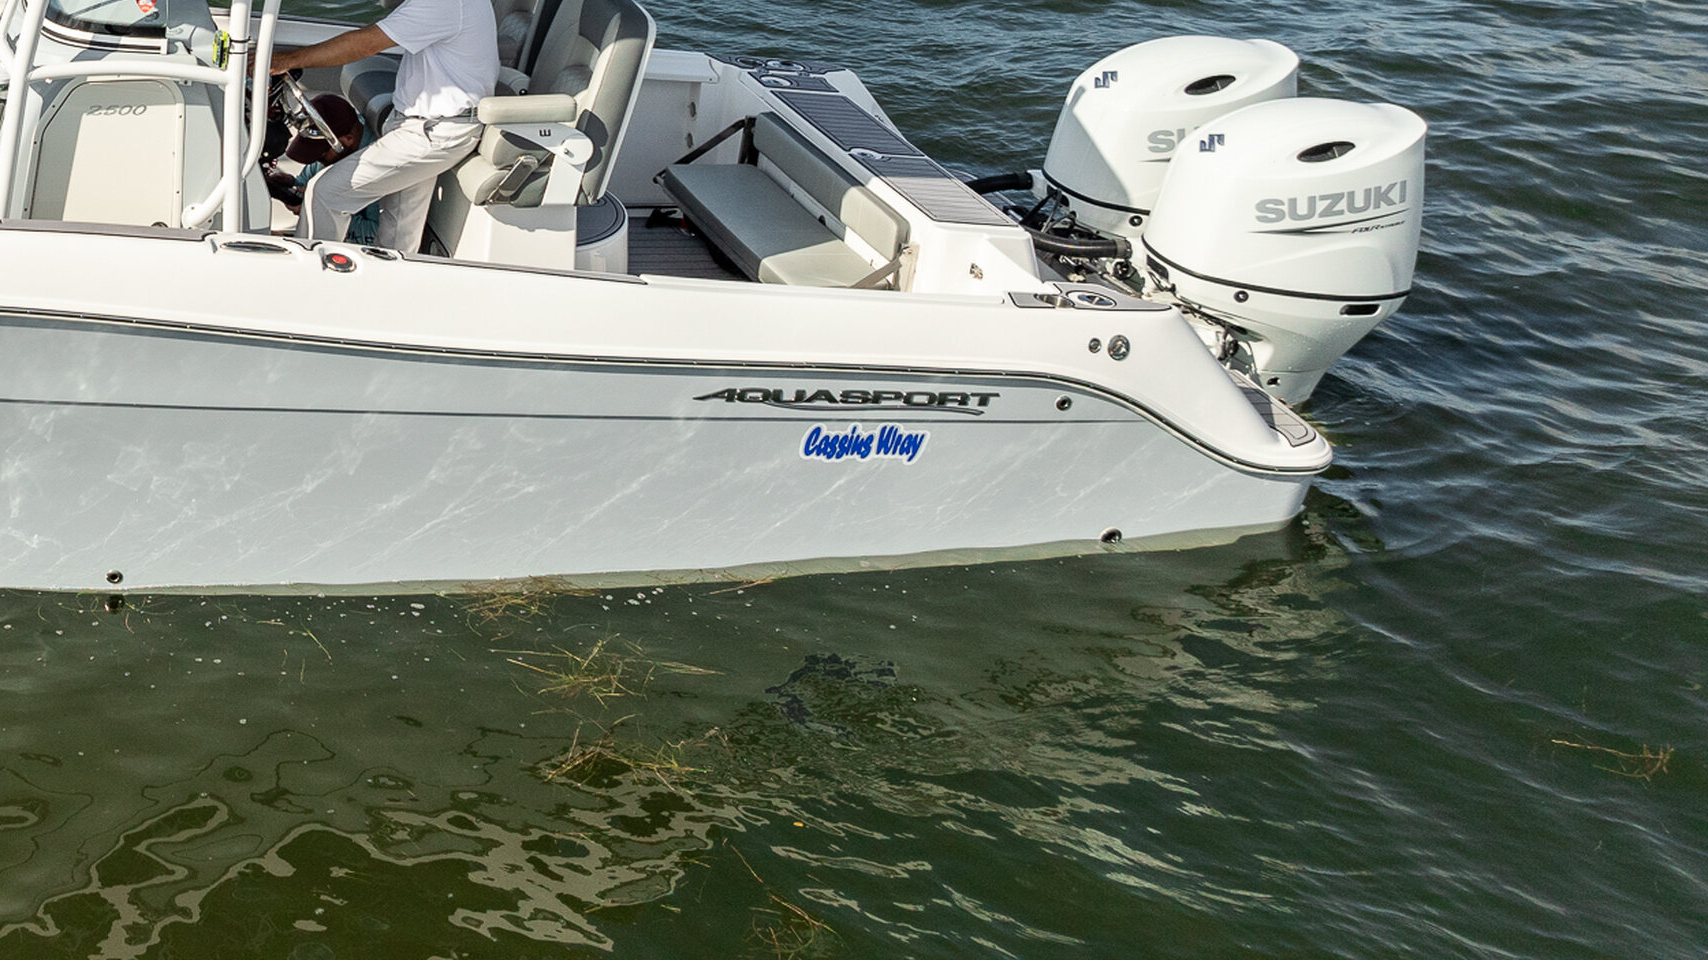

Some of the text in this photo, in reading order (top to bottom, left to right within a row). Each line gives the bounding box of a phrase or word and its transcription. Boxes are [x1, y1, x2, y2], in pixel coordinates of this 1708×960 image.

[86, 103, 148, 116] 2500
[1254, 180, 1407, 224] SUZUKI
[692, 387, 1001, 411] AQUASPORT
[803, 425, 925, 462] Cassius Wray
